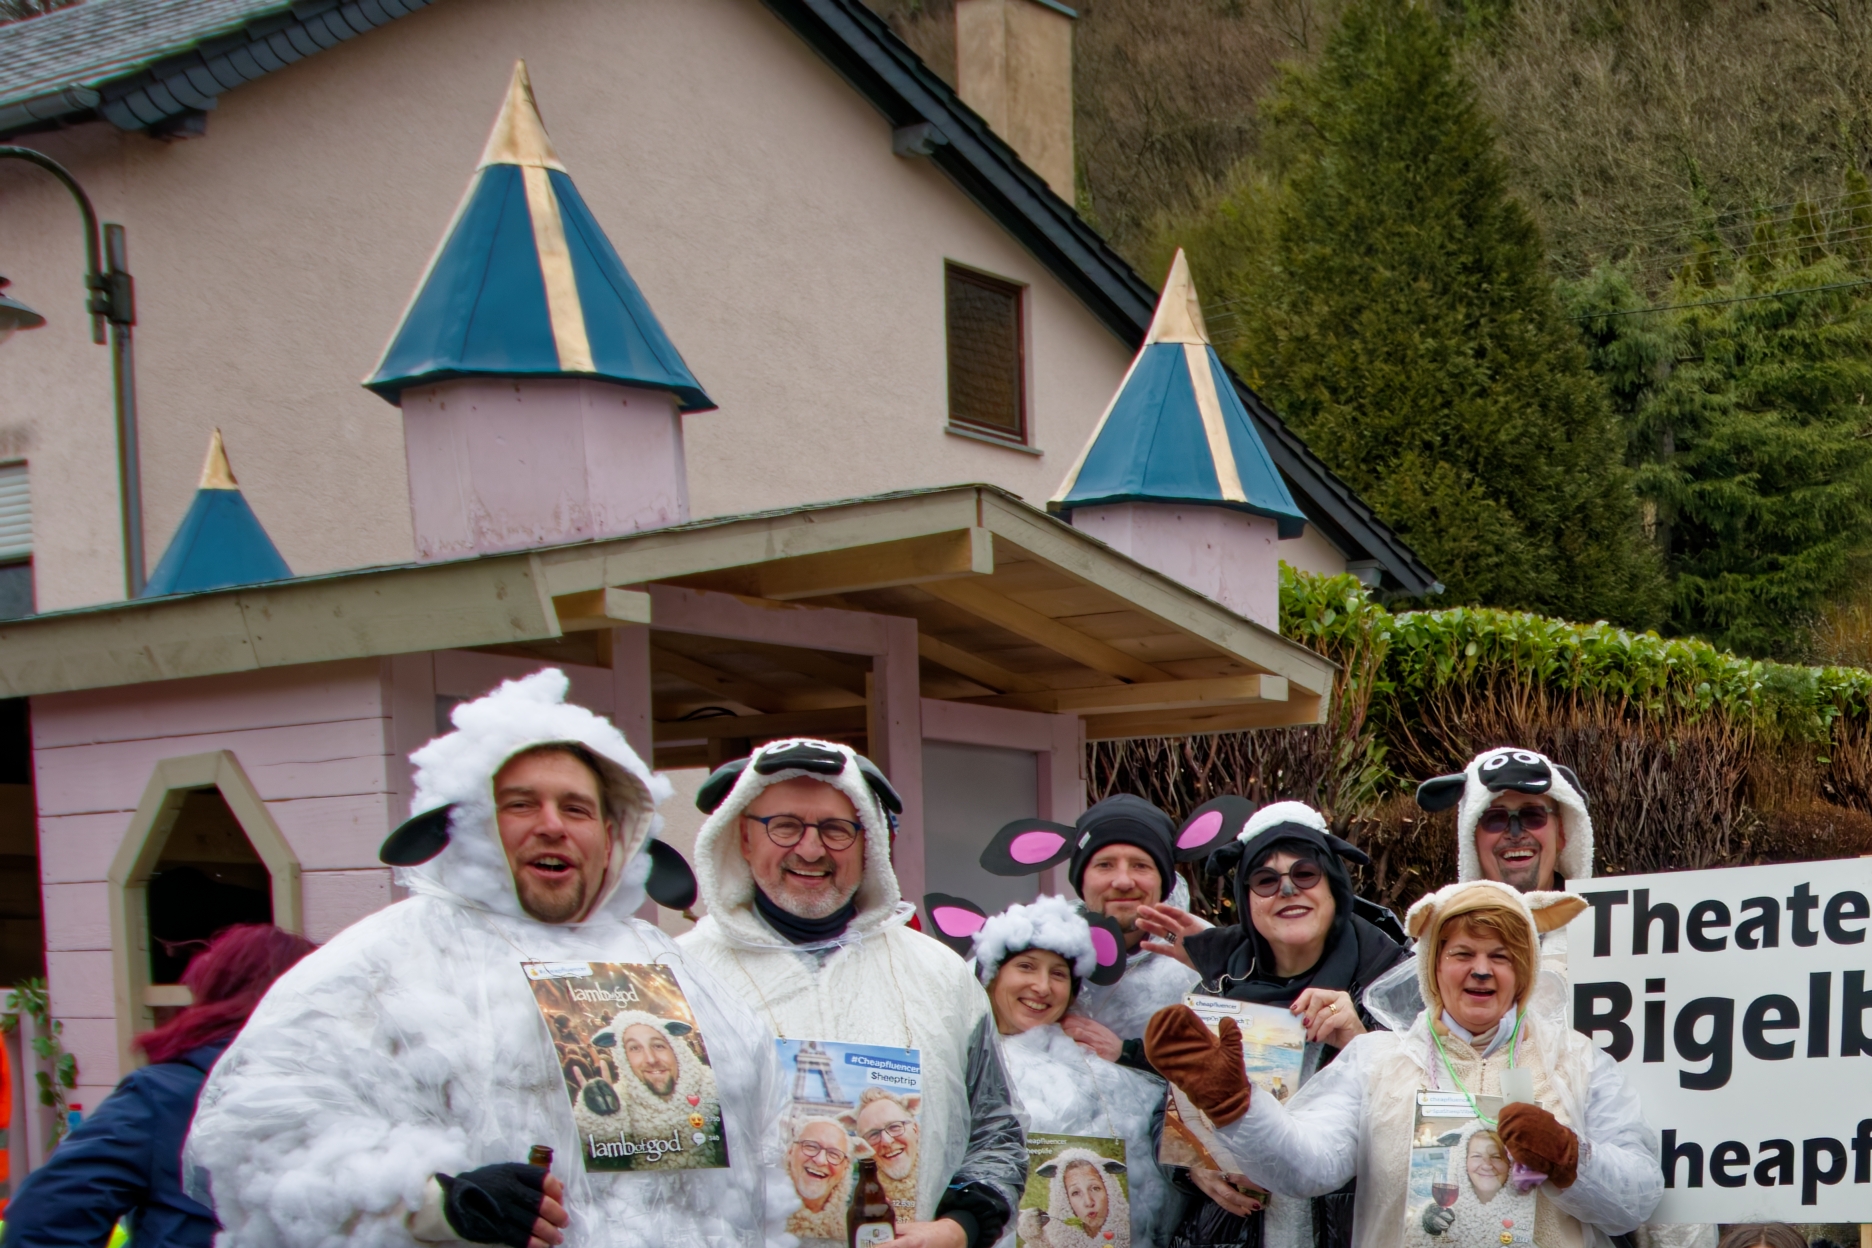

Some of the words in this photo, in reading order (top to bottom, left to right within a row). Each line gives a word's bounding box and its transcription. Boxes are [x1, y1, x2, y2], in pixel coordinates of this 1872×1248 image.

[565, 980, 610, 1002] lamb
[614, 984, 640, 1008] god
[851, 1056, 920, 1074] #Cheapfluencer
[871, 1071, 916, 1086] Sheeptrip
[589, 1131, 635, 1158] lamb
[647, 1129, 682, 1161] god
